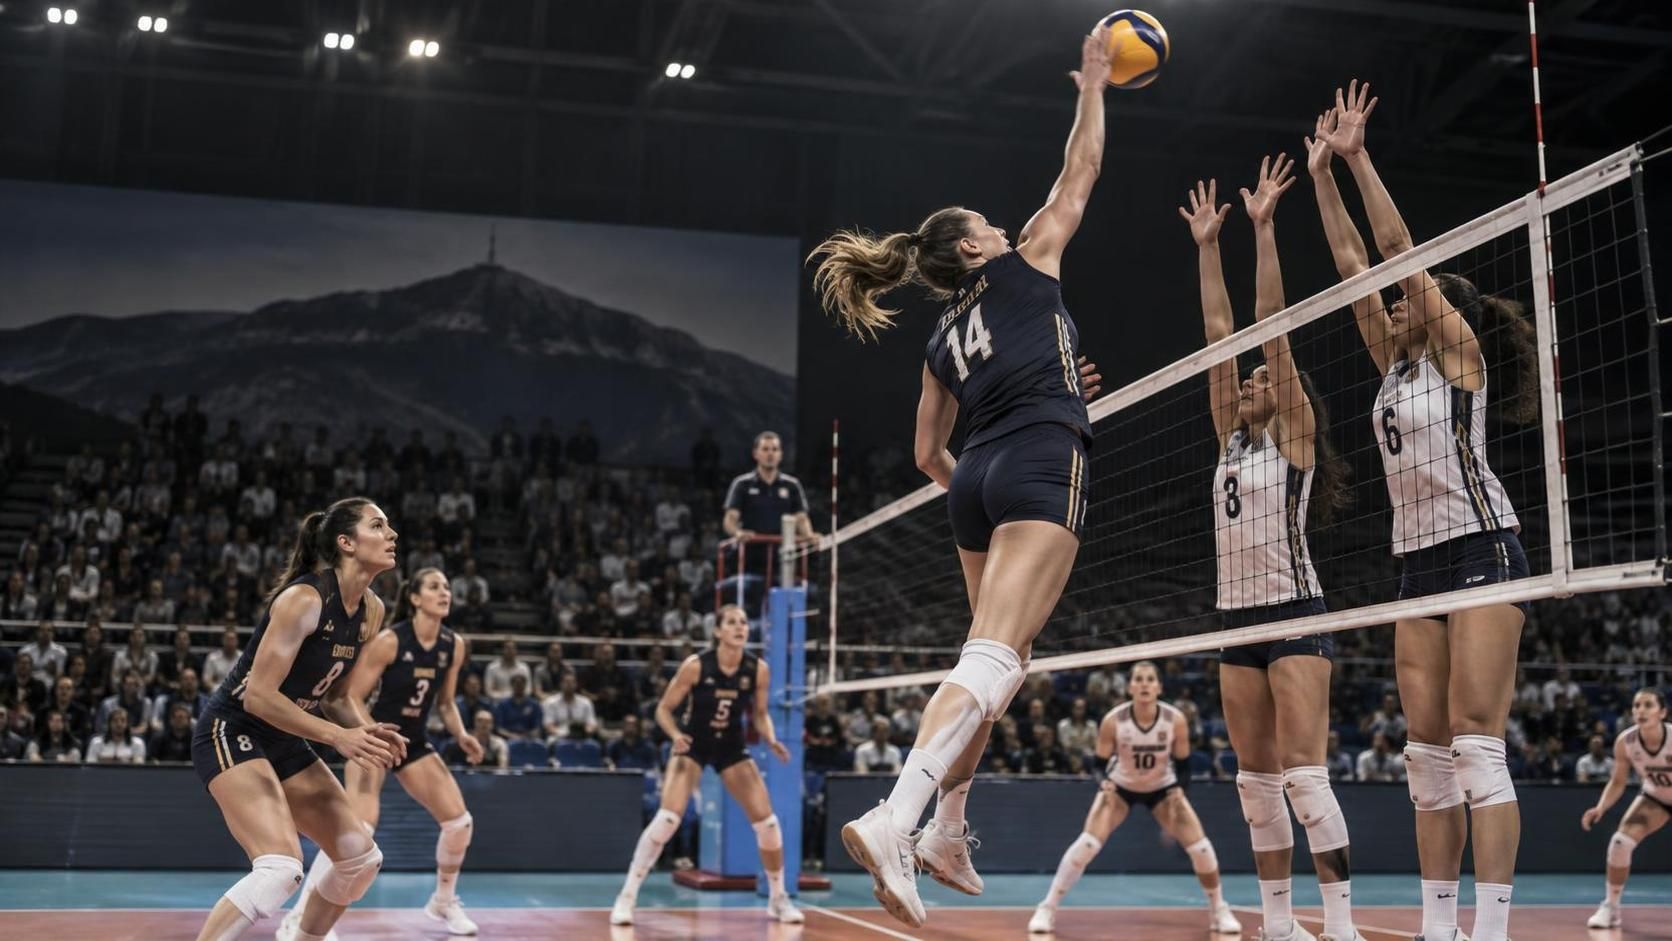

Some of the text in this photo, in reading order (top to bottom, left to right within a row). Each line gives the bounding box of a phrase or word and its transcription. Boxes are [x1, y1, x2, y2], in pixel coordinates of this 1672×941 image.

[947, 303, 993, 382] 14
[1382, 407, 1402, 456] 6
[312, 661, 344, 697] 8
[410, 679, 430, 706] 3
[715, 700, 732, 720] 5
[237, 735, 253, 751] 8
[1133, 753, 1156, 769] 10
[1648, 773, 1672, 787] 10
